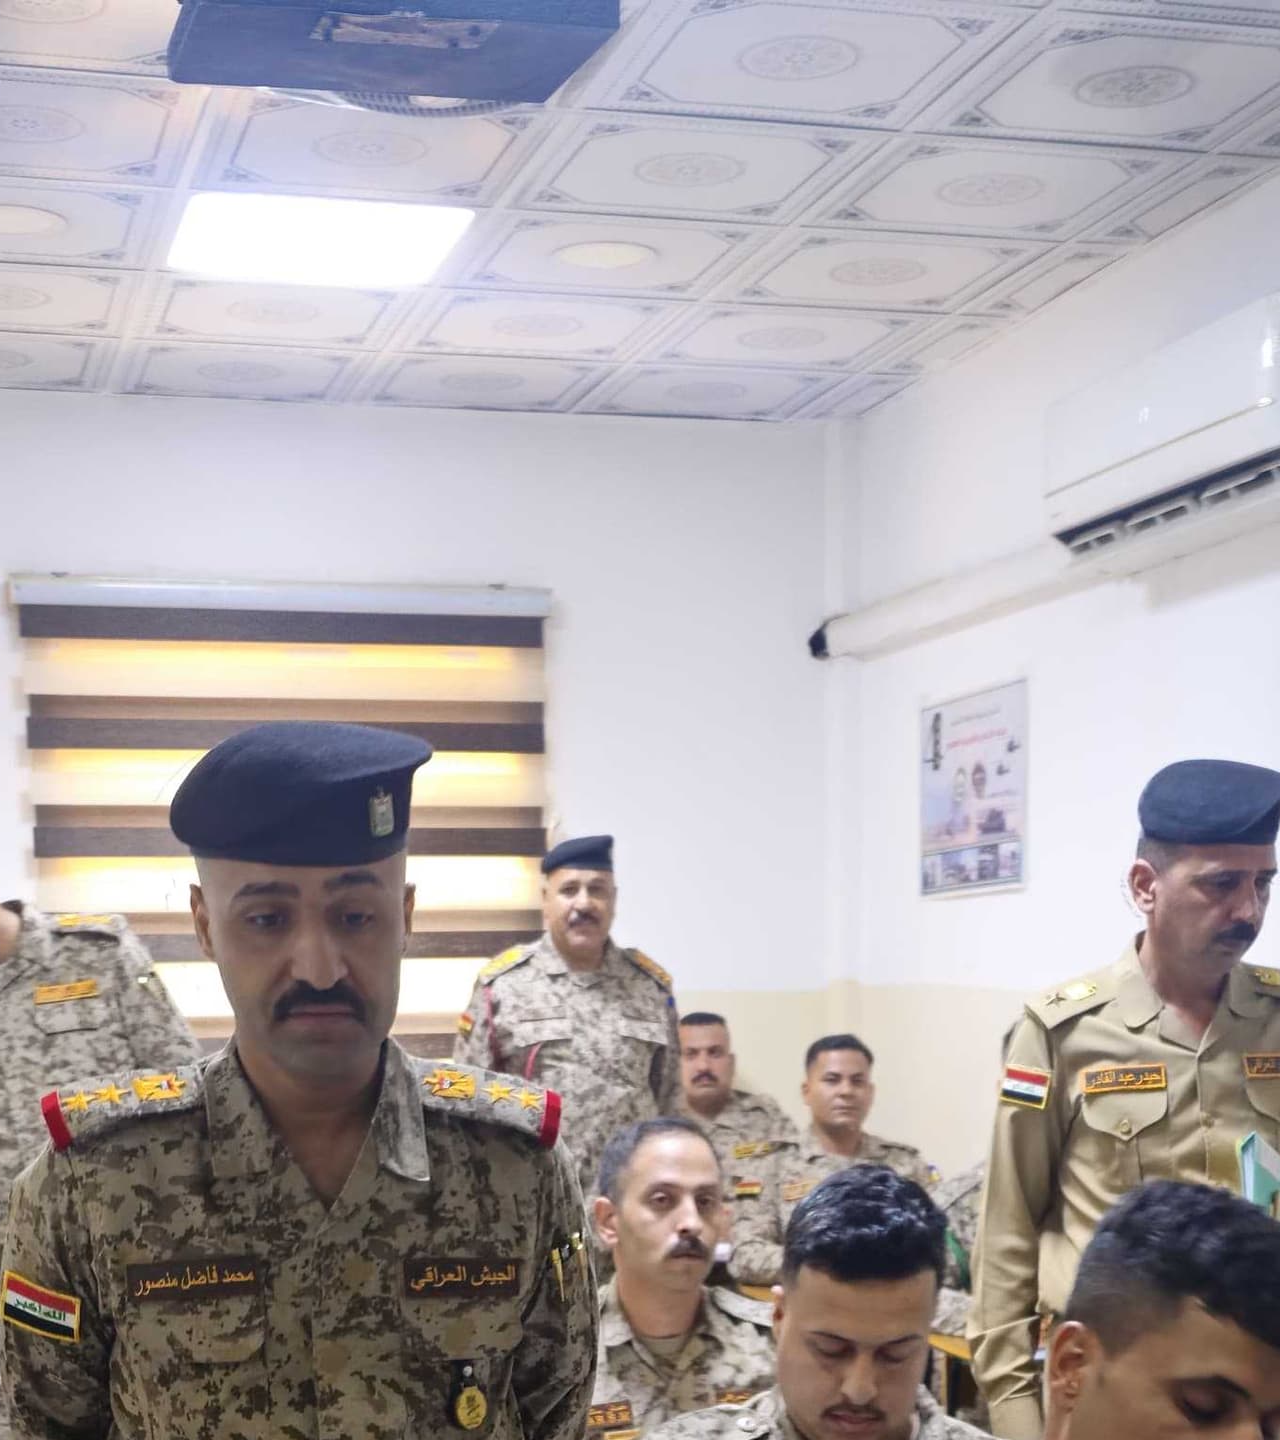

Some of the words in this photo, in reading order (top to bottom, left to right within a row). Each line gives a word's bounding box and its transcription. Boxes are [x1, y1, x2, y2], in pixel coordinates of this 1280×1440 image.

[134, 1271, 179, 1297] منصور
[181, 1264, 218, 1291] فاضل
[222, 1268, 255, 1283] محمد
[410, 1264, 467, 1292] العراقي
[470, 1264, 516, 1287] الجيش
